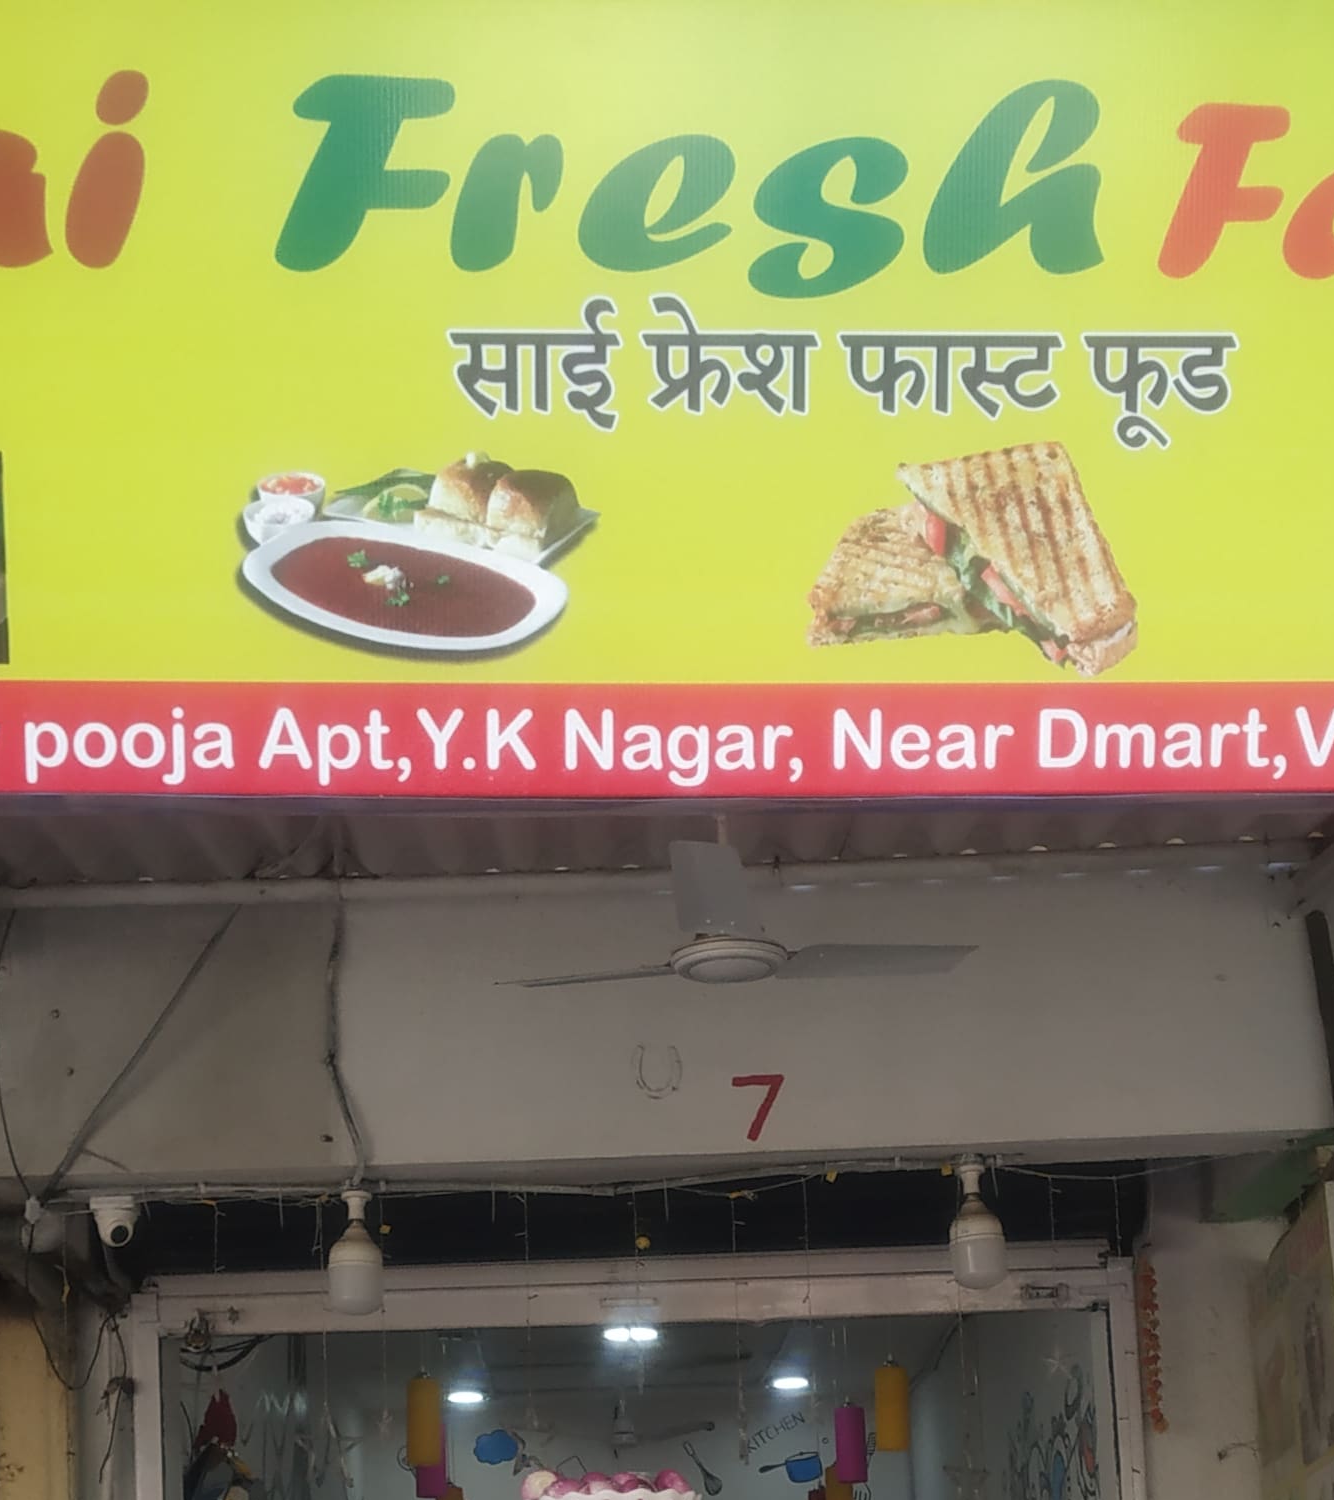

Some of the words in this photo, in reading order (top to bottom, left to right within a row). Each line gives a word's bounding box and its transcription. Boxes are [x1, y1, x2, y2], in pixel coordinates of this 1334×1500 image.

[274, 71, 1104, 299] Fresh
[447, 296, 621, 428] साई
[642, 295, 817, 416] फ्रेश
[841, 330, 1062, 416] फास्ट
[1081, 332, 1239, 450] फूड
[24, 706, 235, 786] pooja
[563, 707, 804, 788] Nagar,
[832, 707, 1015, 771] Near
[731, 1074, 784, 1141] 7
